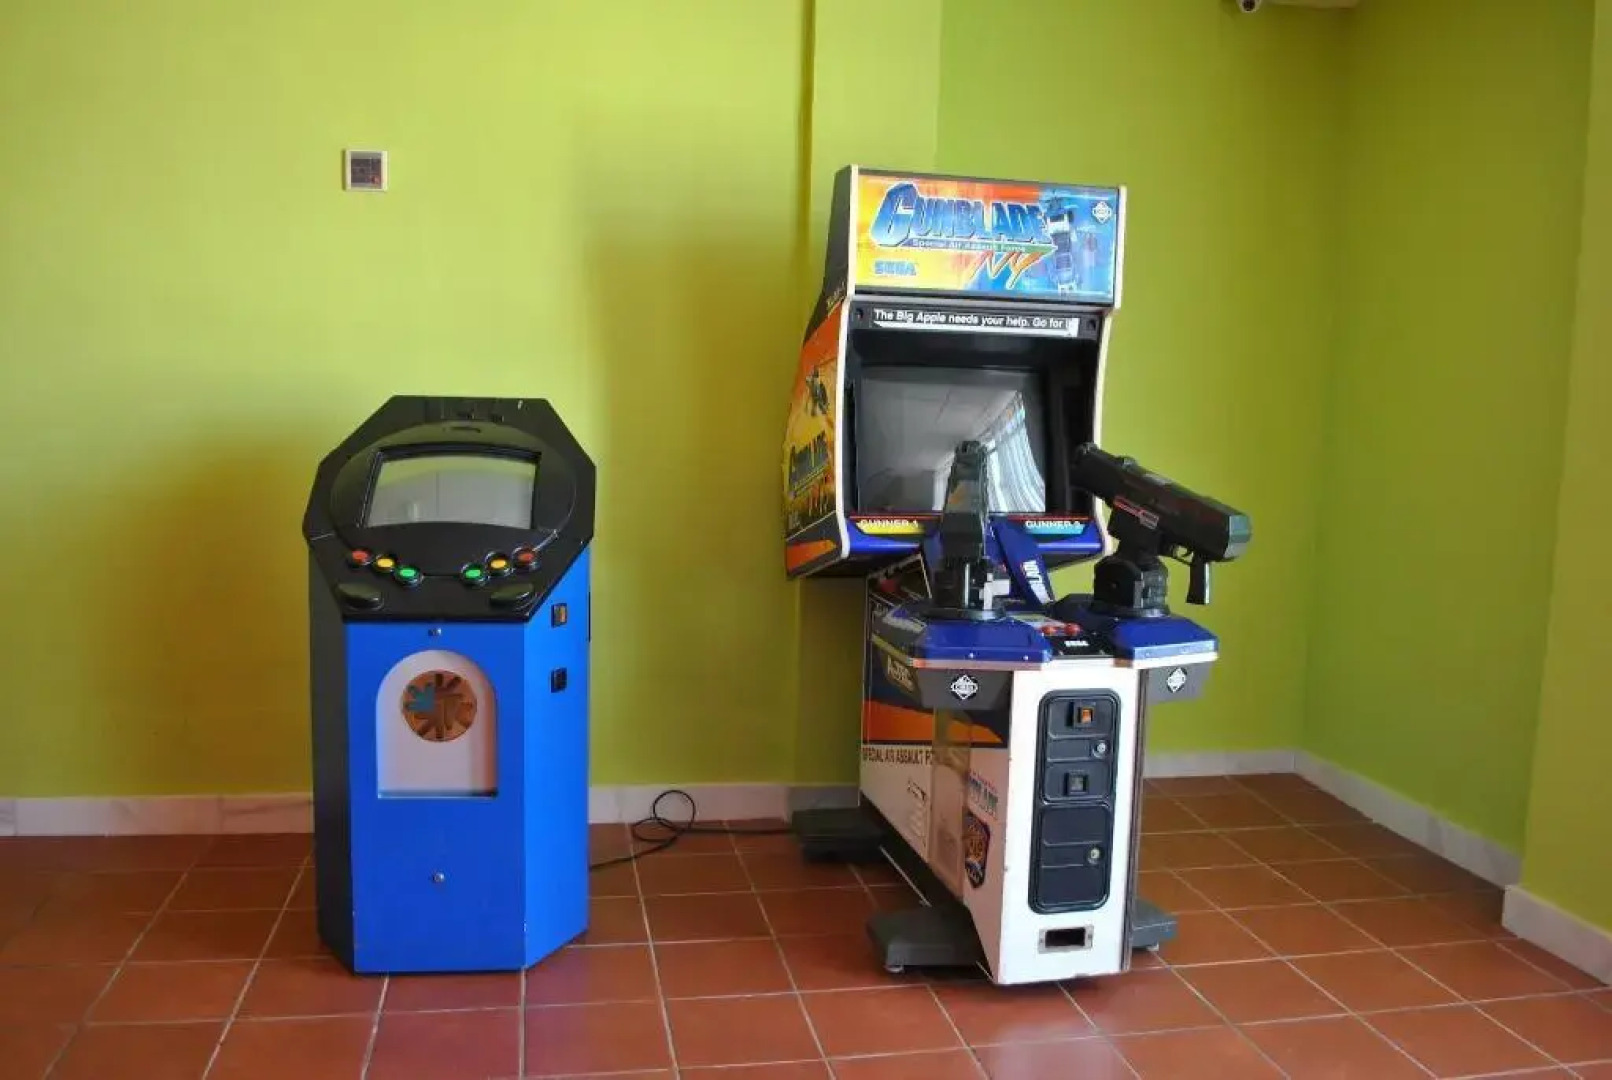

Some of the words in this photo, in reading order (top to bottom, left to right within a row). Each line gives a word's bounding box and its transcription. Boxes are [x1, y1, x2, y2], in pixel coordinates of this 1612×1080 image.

[874, 308, 894, 320] The
[896, 310, 914, 323] Big
[916, 311, 947, 325] Apple
[948, 314, 979, 325] needs
[981, 316, 1005, 328] your
[1006, 316, 1030, 329] help.
[1032, 317, 1048, 328] Go
[1049, 317, 1064, 328] for
